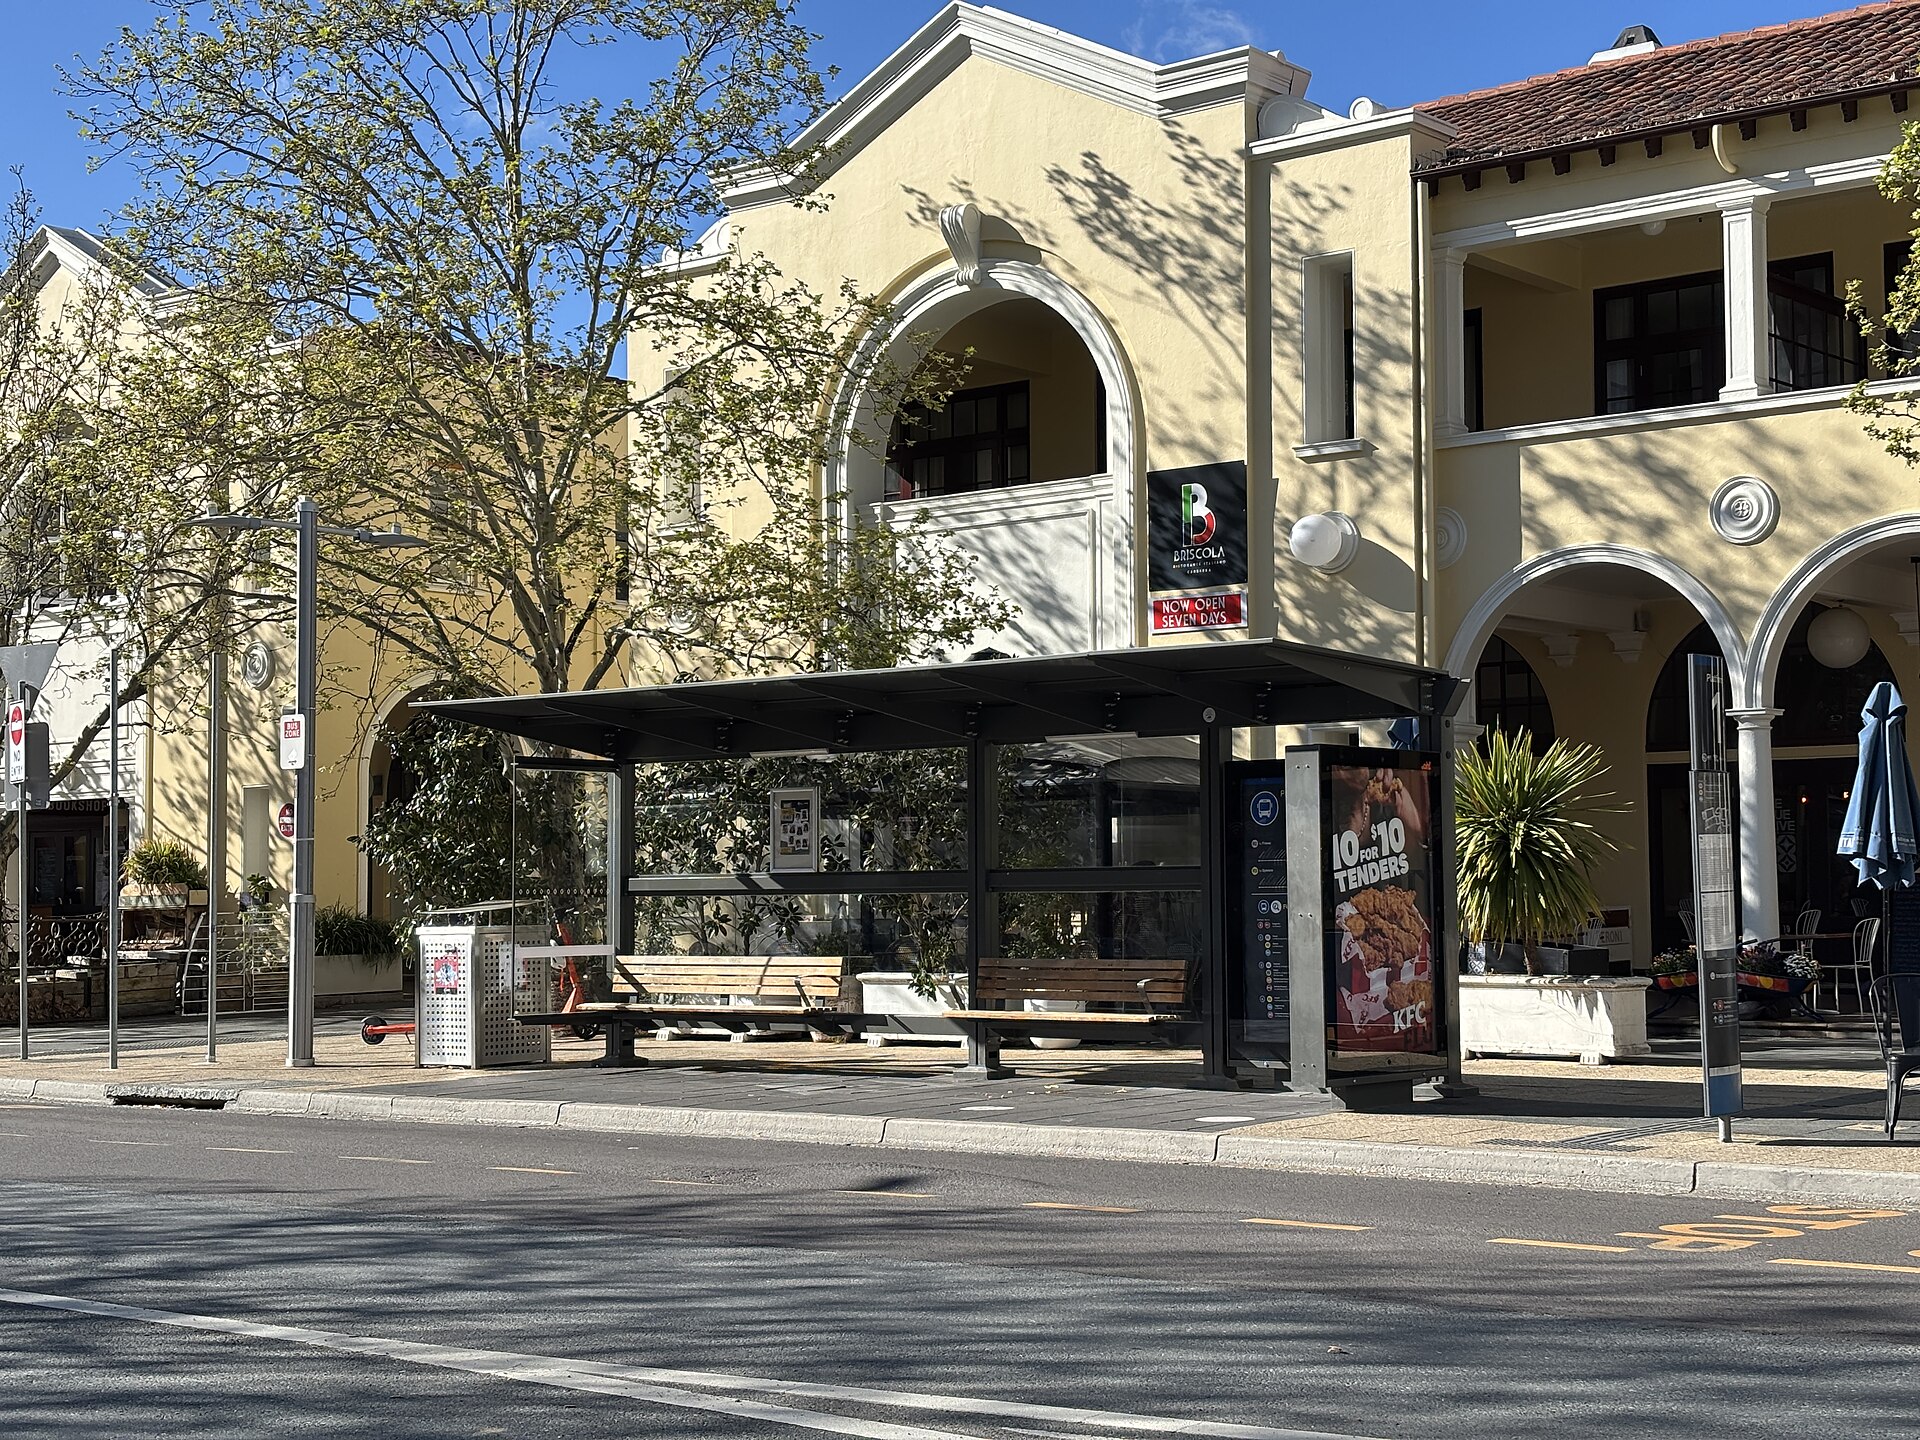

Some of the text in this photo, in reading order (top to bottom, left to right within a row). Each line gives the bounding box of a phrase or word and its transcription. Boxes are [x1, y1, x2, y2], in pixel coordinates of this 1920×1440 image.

[1181, 482, 1216, 548] B
[1173, 546, 1225, 562] BRISCOLA
[1162, 596, 1226, 614] NOW OPEN
[1162, 611, 1227, 628] SEVEN DAYS
[284, 729, 300, 738] ZONE
[286, 722, 298, 730] BUS
[13, 750, 21, 762] NO
[280, 824, 293, 833] ENTR
[1332, 817, 1406, 871] 10 FOR $10
[1333, 852, 1410, 893] TENDERS
[1392, 1001, 1426, 1034] KFC
[1614, 1205, 1908, 1252] STOP
